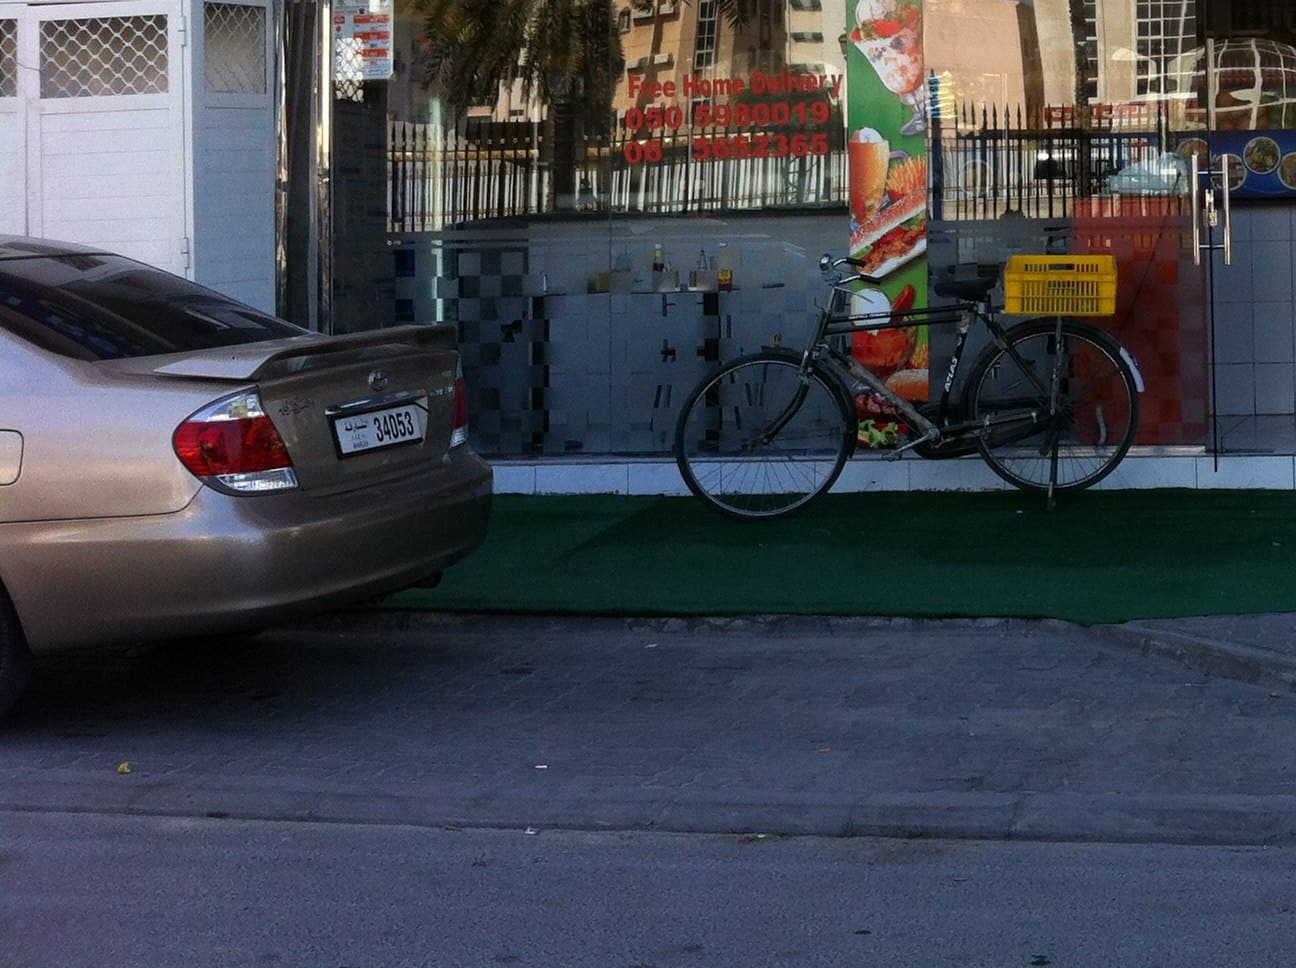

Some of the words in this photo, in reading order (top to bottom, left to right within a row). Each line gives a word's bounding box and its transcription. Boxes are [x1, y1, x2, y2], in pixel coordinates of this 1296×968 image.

[628, 75, 675, 98] Free
[683, 73, 745, 97] Home
[625, 106, 684, 130] 050
[694, 101, 831, 128] 5980019
[624, 138, 663, 164] 06
[692, 132, 829, 161] 5652365
[373, 411, 414, 442] 34053
